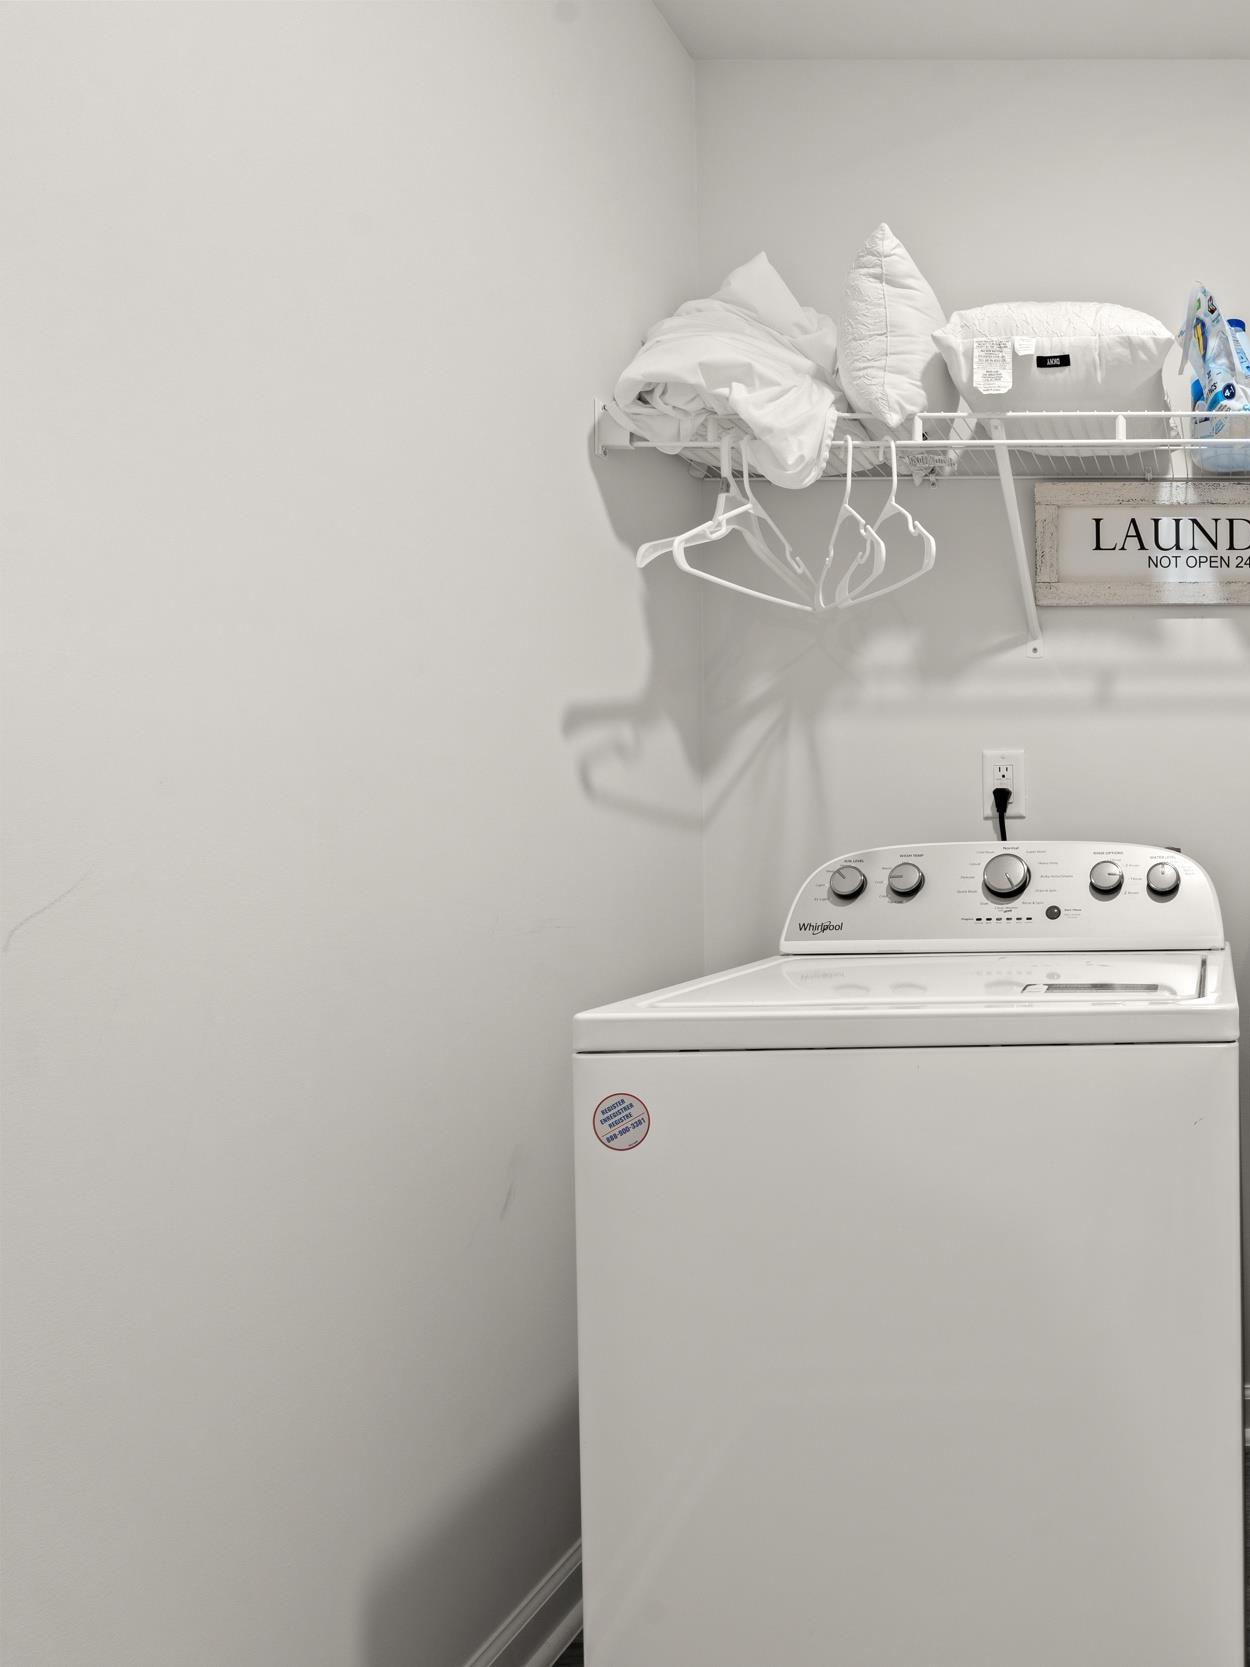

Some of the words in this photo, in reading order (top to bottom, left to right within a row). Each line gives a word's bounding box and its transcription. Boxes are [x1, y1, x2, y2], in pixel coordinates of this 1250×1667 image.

[1148, 555, 1181, 569] NOT
[1185, 555, 1230, 569] OPEN
[798, 920, 844, 935] Whirlpool
[601, 1099, 625, 1115] REGISTER
